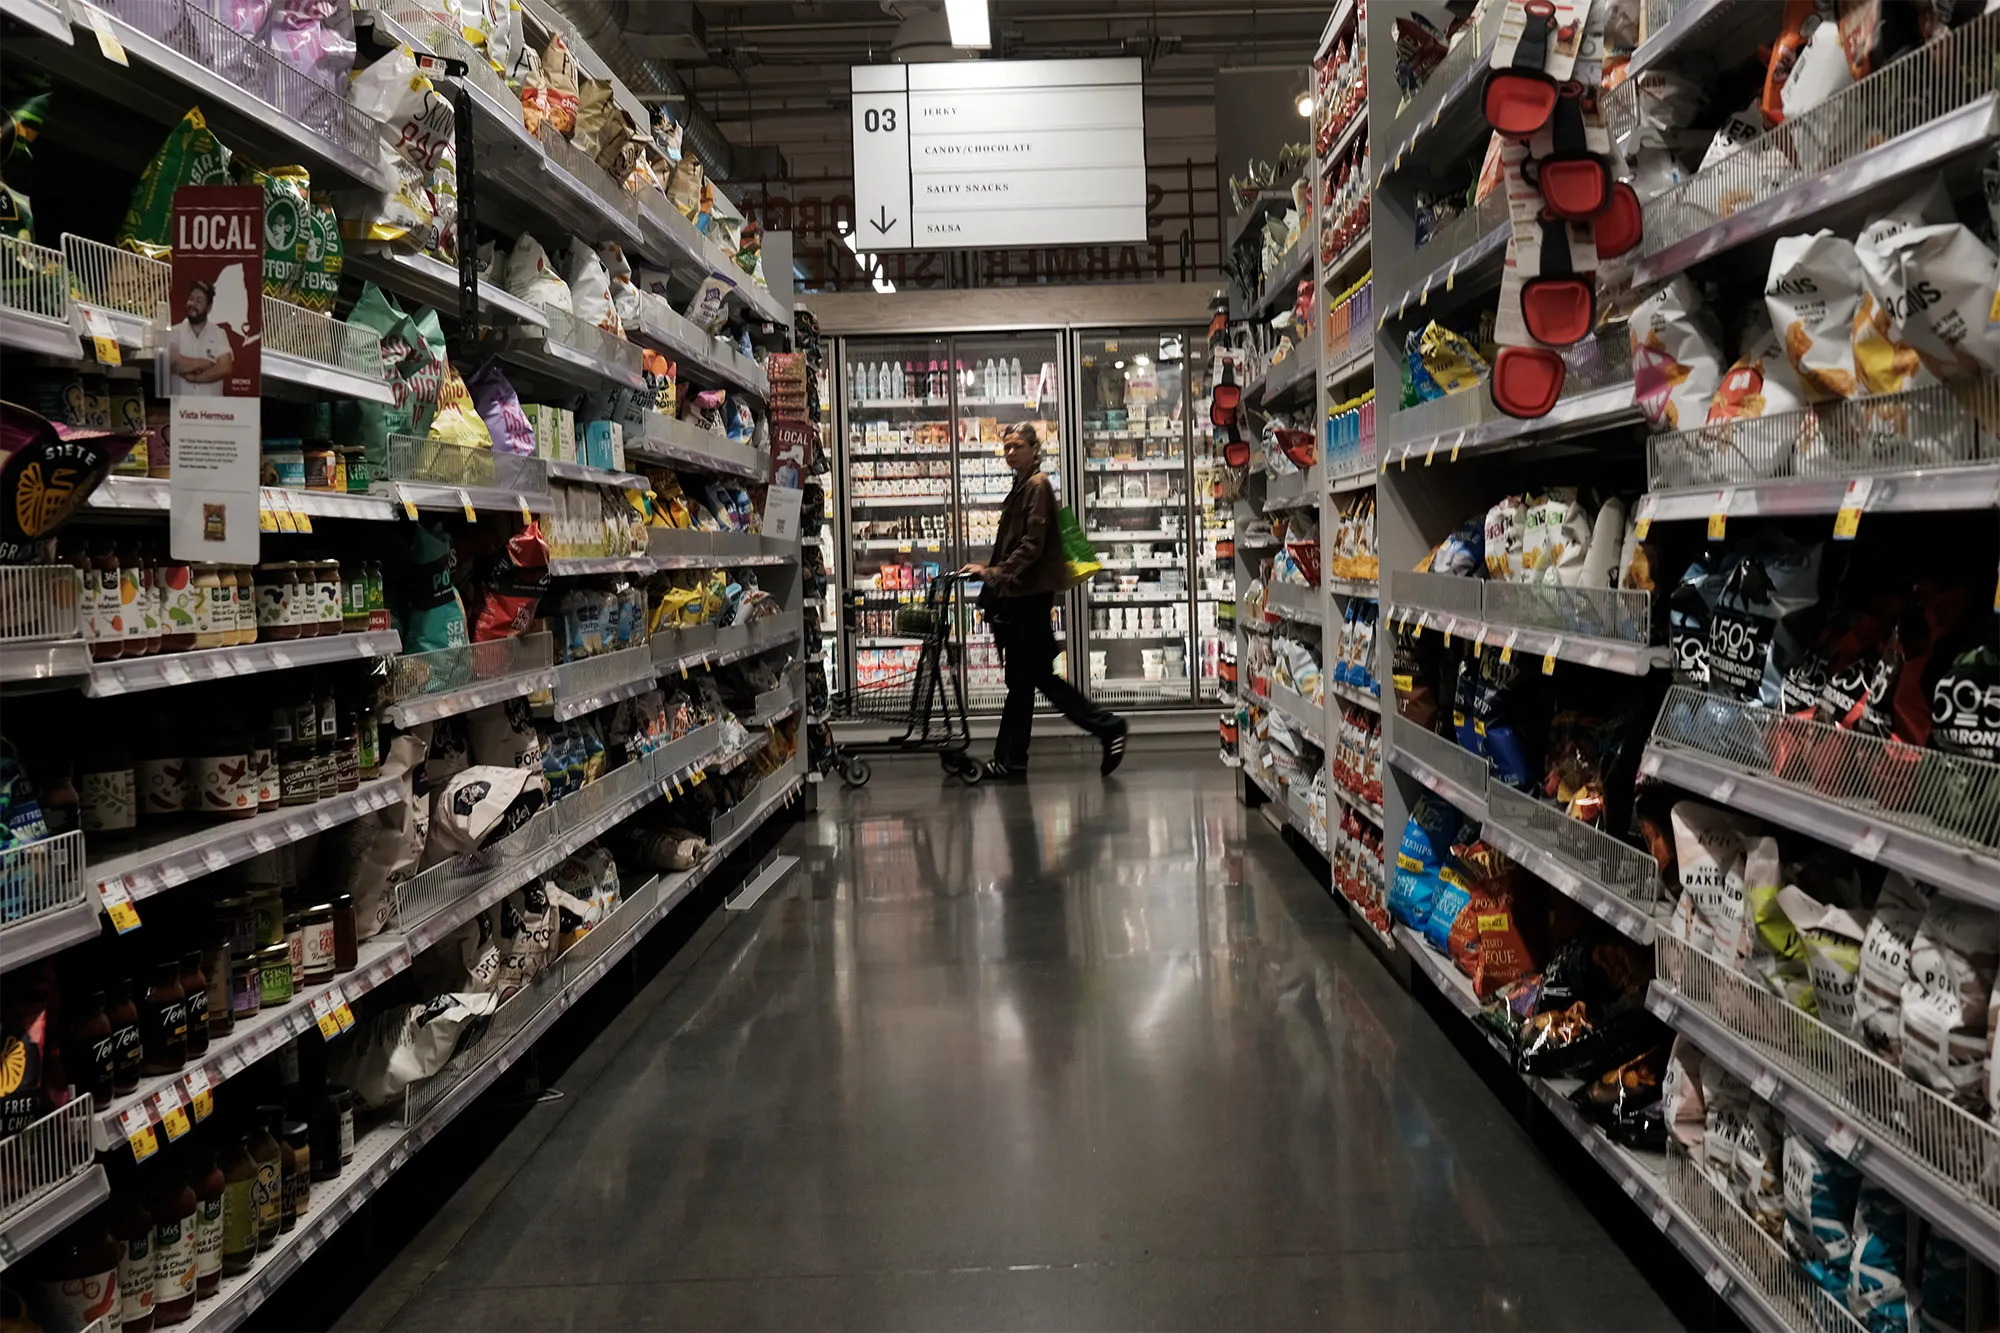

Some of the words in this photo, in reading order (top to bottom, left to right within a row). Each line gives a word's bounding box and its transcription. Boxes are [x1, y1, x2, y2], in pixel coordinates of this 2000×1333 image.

[924, 107, 957, 117] JERKY
[864, 108, 896, 132] 03
[925, 144, 1032, 155] CANDY/CHOCOLATE
[927, 185, 960, 195] SALTY
[966, 183, 1009, 193] SNACKS
[179, 214, 257, 251] LOCAL
[927, 224, 961, 234] SALSA
[180, 410, 198, 420] Vista
[200, 411, 235, 421] Hermosa
[778, 428, 809, 446] LOCAL
[369, 613, 386, 624] LOCAL
[1709, 614, 1760, 664] 4505
[5, 1097, 33, 1116] FREE
[161, 1226, 180, 1238] 365
